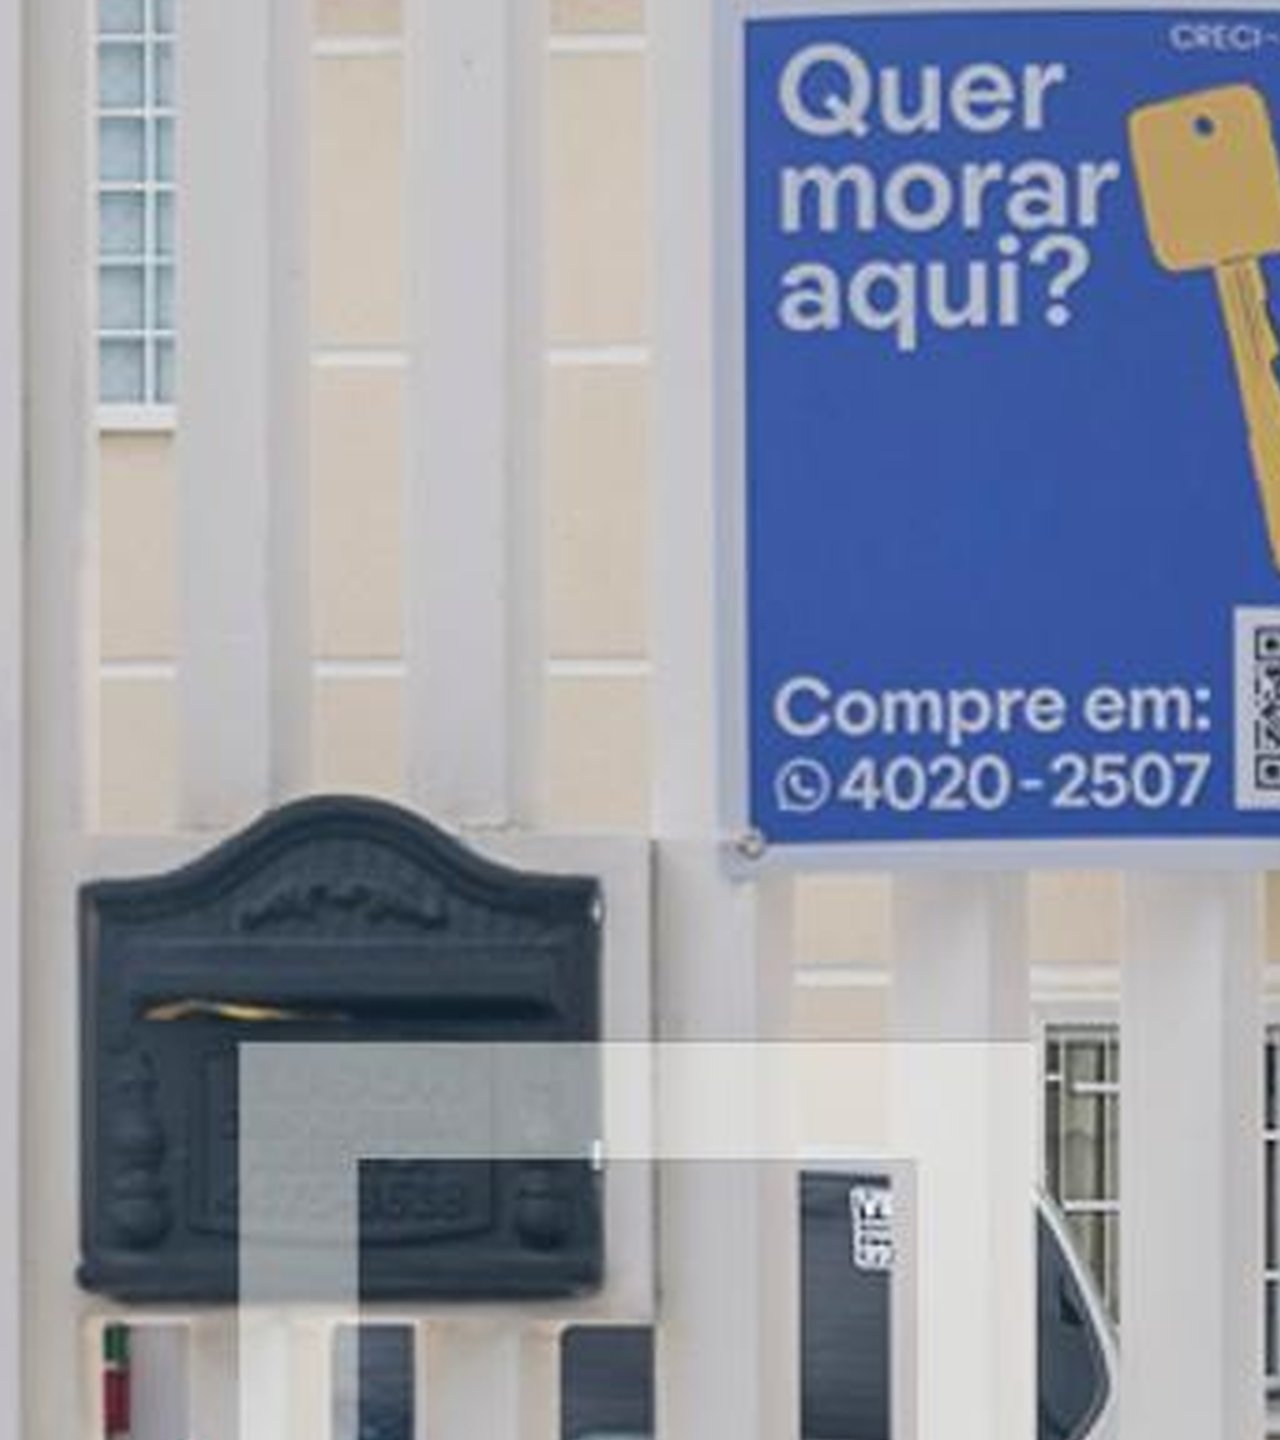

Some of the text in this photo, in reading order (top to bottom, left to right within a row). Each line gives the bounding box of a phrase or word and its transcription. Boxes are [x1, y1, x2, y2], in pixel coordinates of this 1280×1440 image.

[778, 42, 1066, 138] Quer
[780, 160, 1120, 233] morar
[778, 232, 1090, 352] aqui?
[773, 675, 1212, 747] Compre em:
[838, 753, 1212, 811] 4020-2507
